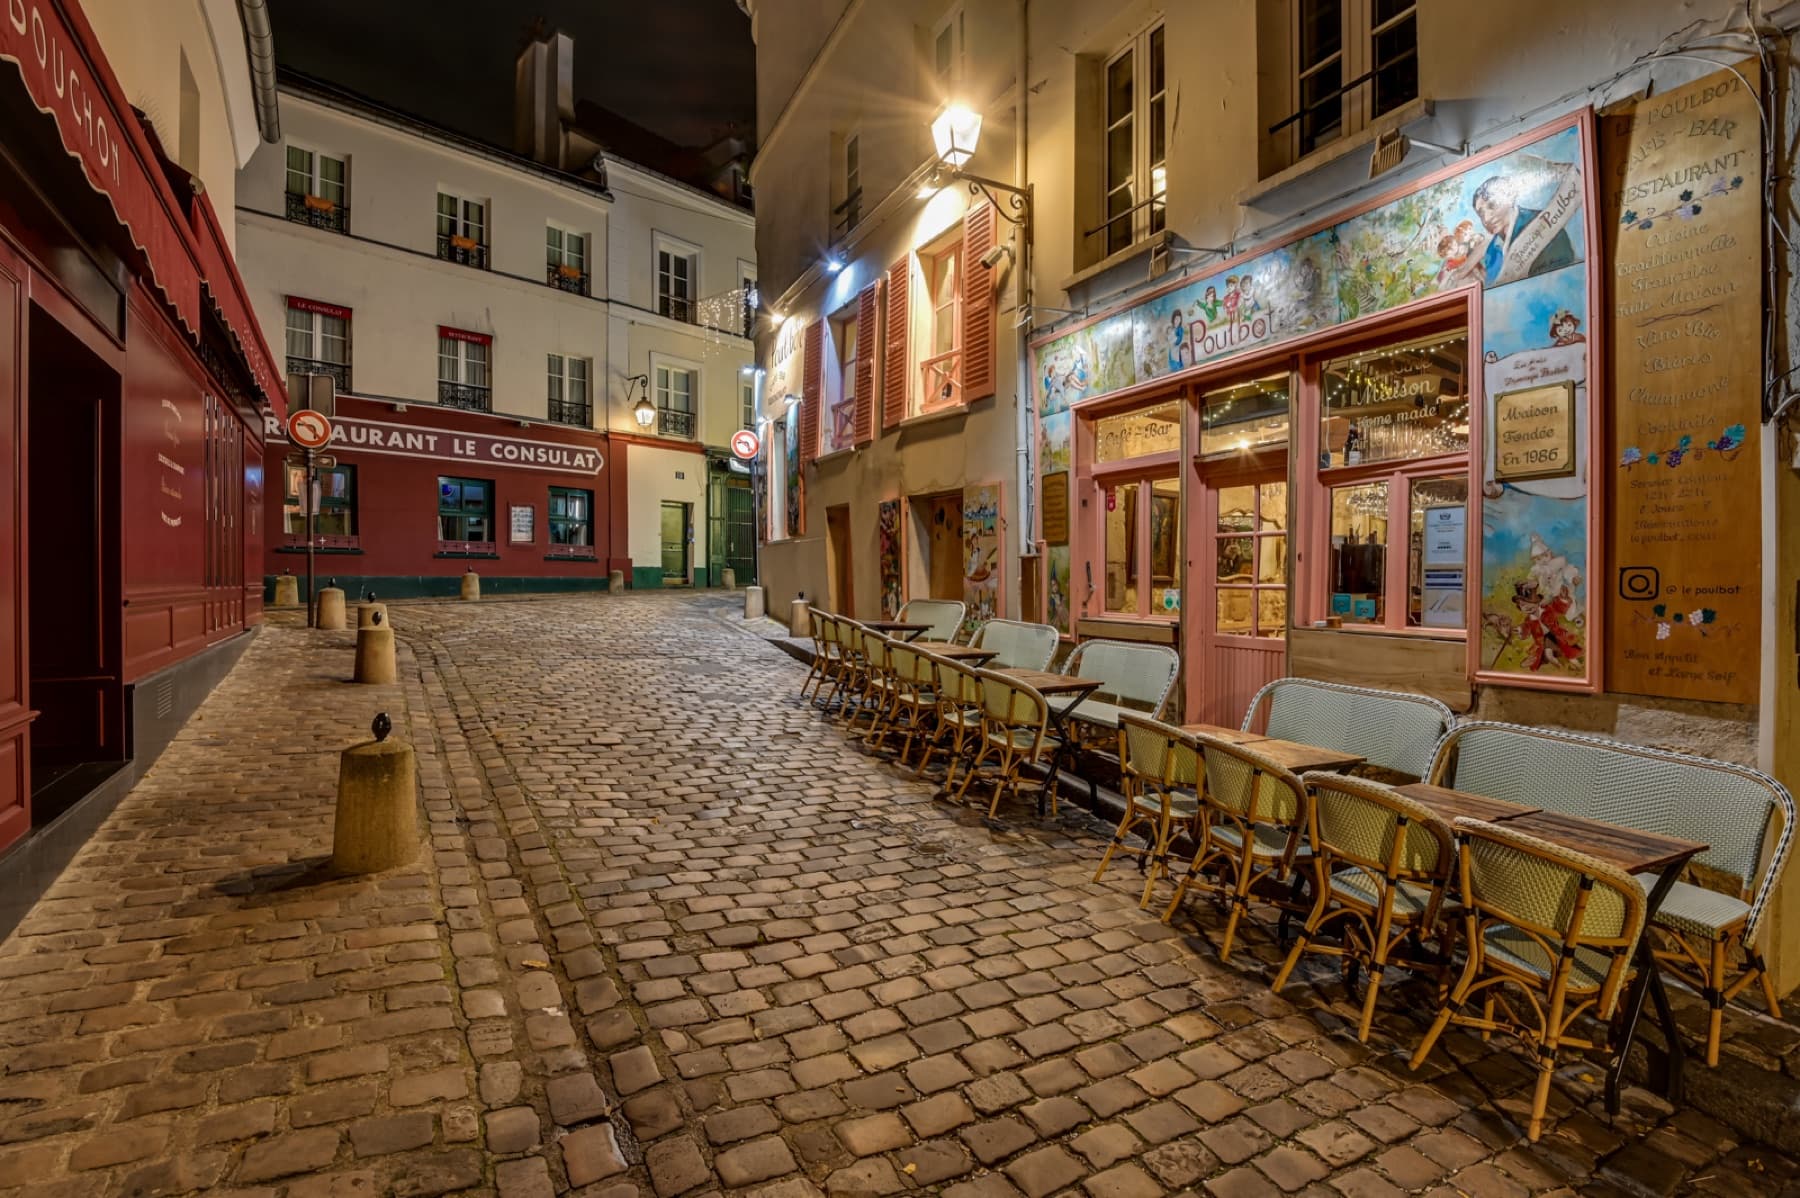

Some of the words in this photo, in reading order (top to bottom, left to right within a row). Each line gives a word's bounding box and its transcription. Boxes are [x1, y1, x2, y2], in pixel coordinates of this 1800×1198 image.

[1647, 79, 1741, 125] POULBOT
[1688, 118, 1738, 139] BAR
[1615, 150, 1745, 208] RESTAURANT
[1182, 302, 1280, 366] Poulbot
[1396, 403, 1438, 420] made
[1502, 405, 1558, 422] Maison
[1144, 422, 1173, 439] Bar
[1502, 426, 1554, 444] Fondée
[264, 416, 438, 451] RAURANT
[453, 438, 477, 456] LE
[490, 442, 596, 468] CONSULAT
[1502, 452, 1520, 466] En
[1522, 447, 1559, 464] 1986
[1695, 584, 1742, 597] poulbot
